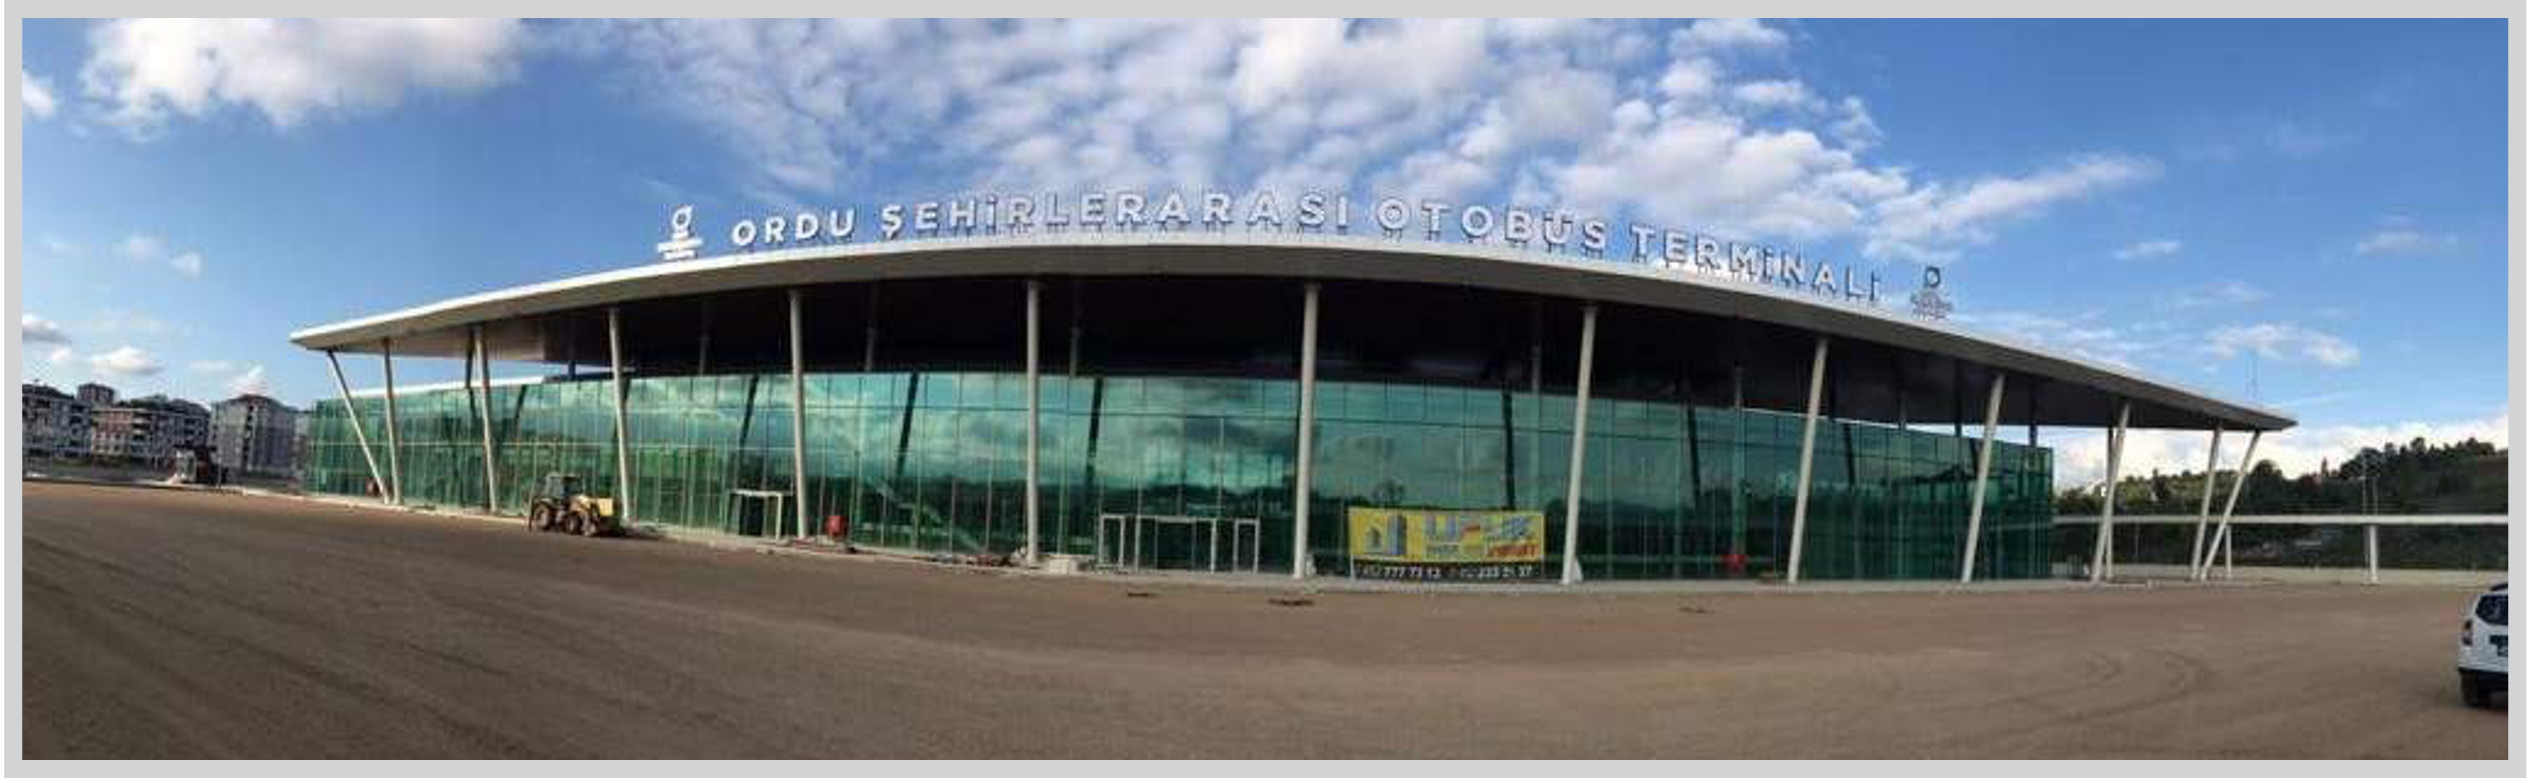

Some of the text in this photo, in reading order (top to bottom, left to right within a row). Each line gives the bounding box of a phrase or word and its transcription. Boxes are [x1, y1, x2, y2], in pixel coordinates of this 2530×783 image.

[731, 207, 856, 247] ORDU
[880, 192, 1350, 239] ŞEHİRLERARASI
[1376, 198, 1607, 249] OTOBÜS
